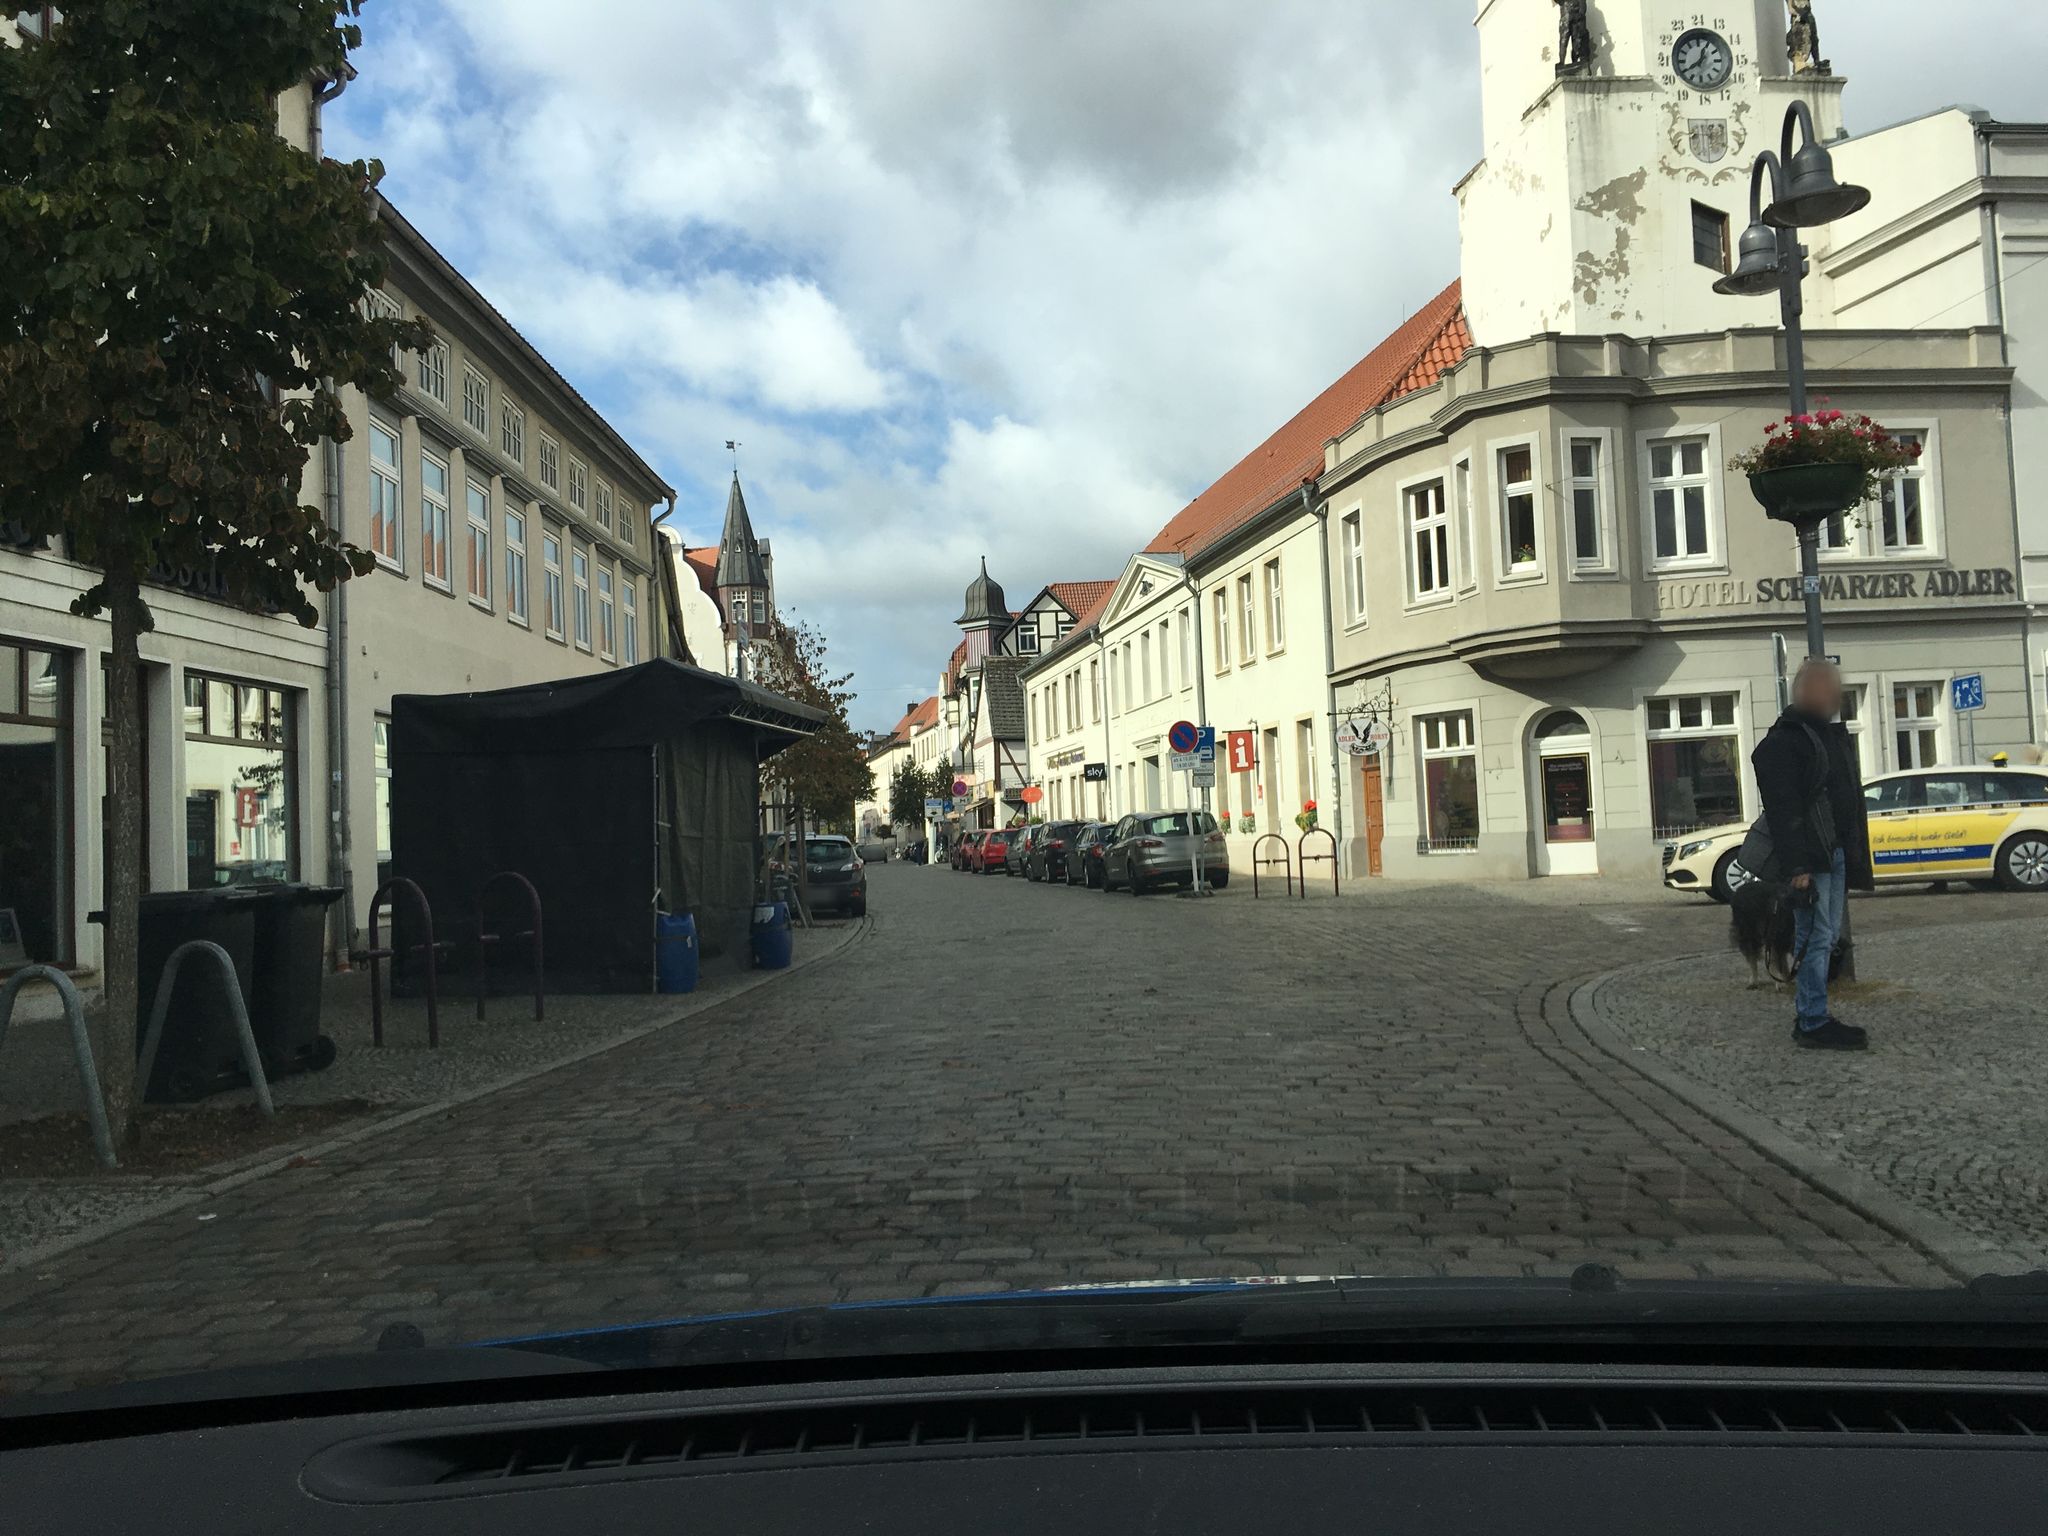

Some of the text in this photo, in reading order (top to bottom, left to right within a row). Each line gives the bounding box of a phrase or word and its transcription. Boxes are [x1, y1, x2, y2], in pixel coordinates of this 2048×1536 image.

[1671, 20, 1684, 31] 23
[1691, 14, 1704, 26] 24
[1714, 18, 1725, 29] 13
[1660, 34, 1672, 45] 22
[1730, 33, 1740, 45] 14
[1658, 52, 1669, 67] 21
[1736, 54, 1748, 65] 15
[1662, 74, 1676, 85] 20
[1734, 72, 1745, 84] 16
[1678, 89, 1688, 100] 19
[1700, 94, 1711, 105] 18
[1720, 89, 1730, 100] 17
[1653, 581, 1751, 611] HOTEL
[1924, 568, 2015, 598] ADLER
[1087, 767, 1103, 777] sky
